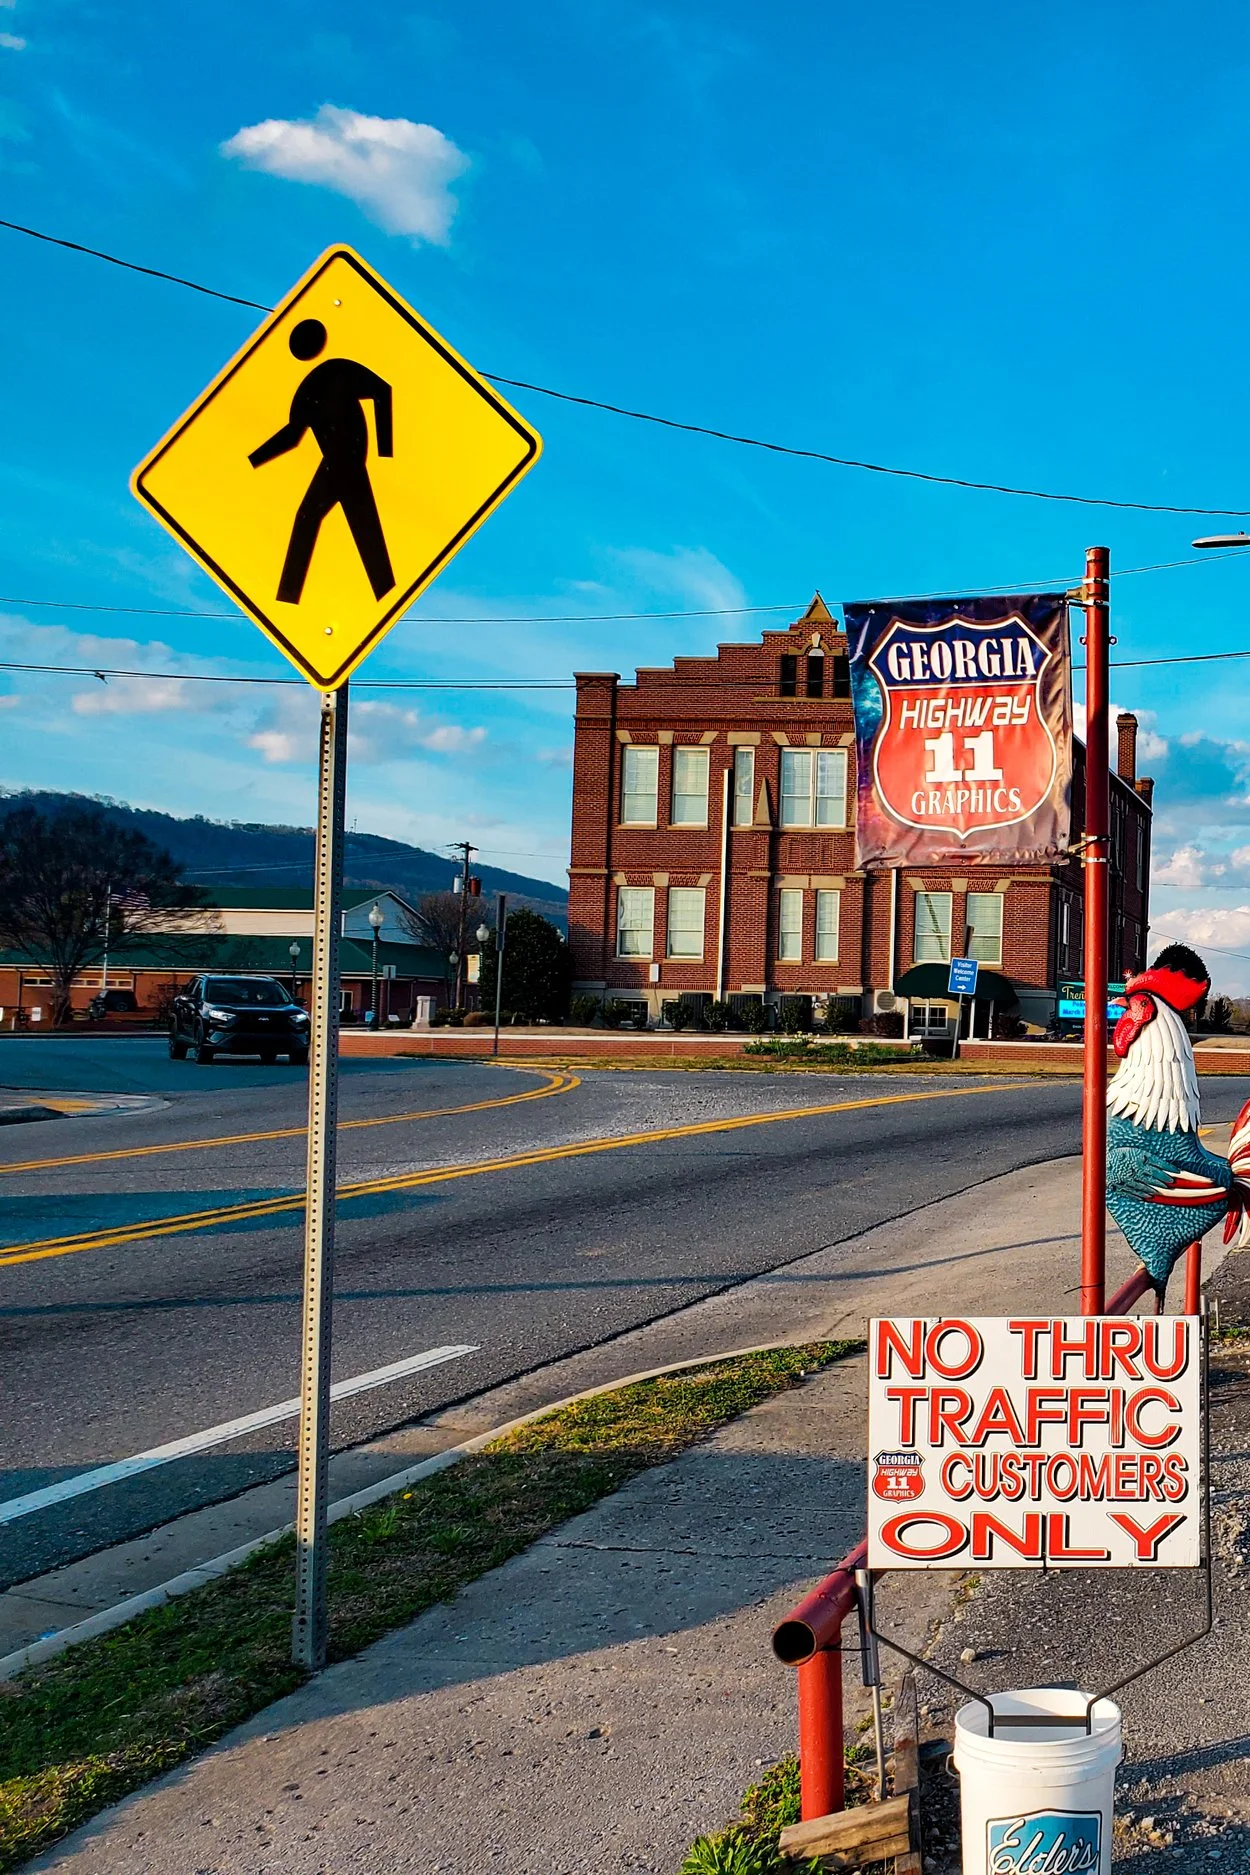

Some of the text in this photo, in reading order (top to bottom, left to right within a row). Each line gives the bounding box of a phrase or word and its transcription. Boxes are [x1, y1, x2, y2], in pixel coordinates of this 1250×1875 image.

[887, 637, 1036, 681] GEORGIA
[924, 731, 1003, 782] 11
[911, 788, 1021, 815] GRAPHICS
[876, 1319, 1190, 1382] NO THRU
[885, 1386, 1183, 1449] TRAFFIC
[879, 1455, 920, 1465] GEORGIA
[887, 1476, 910, 1489] 11
[940, 1450, 1189, 1502] CUSTOMERS
[879, 1510, 1188, 1562] ONLY
[989, 1818, 1098, 1875] Elder's
